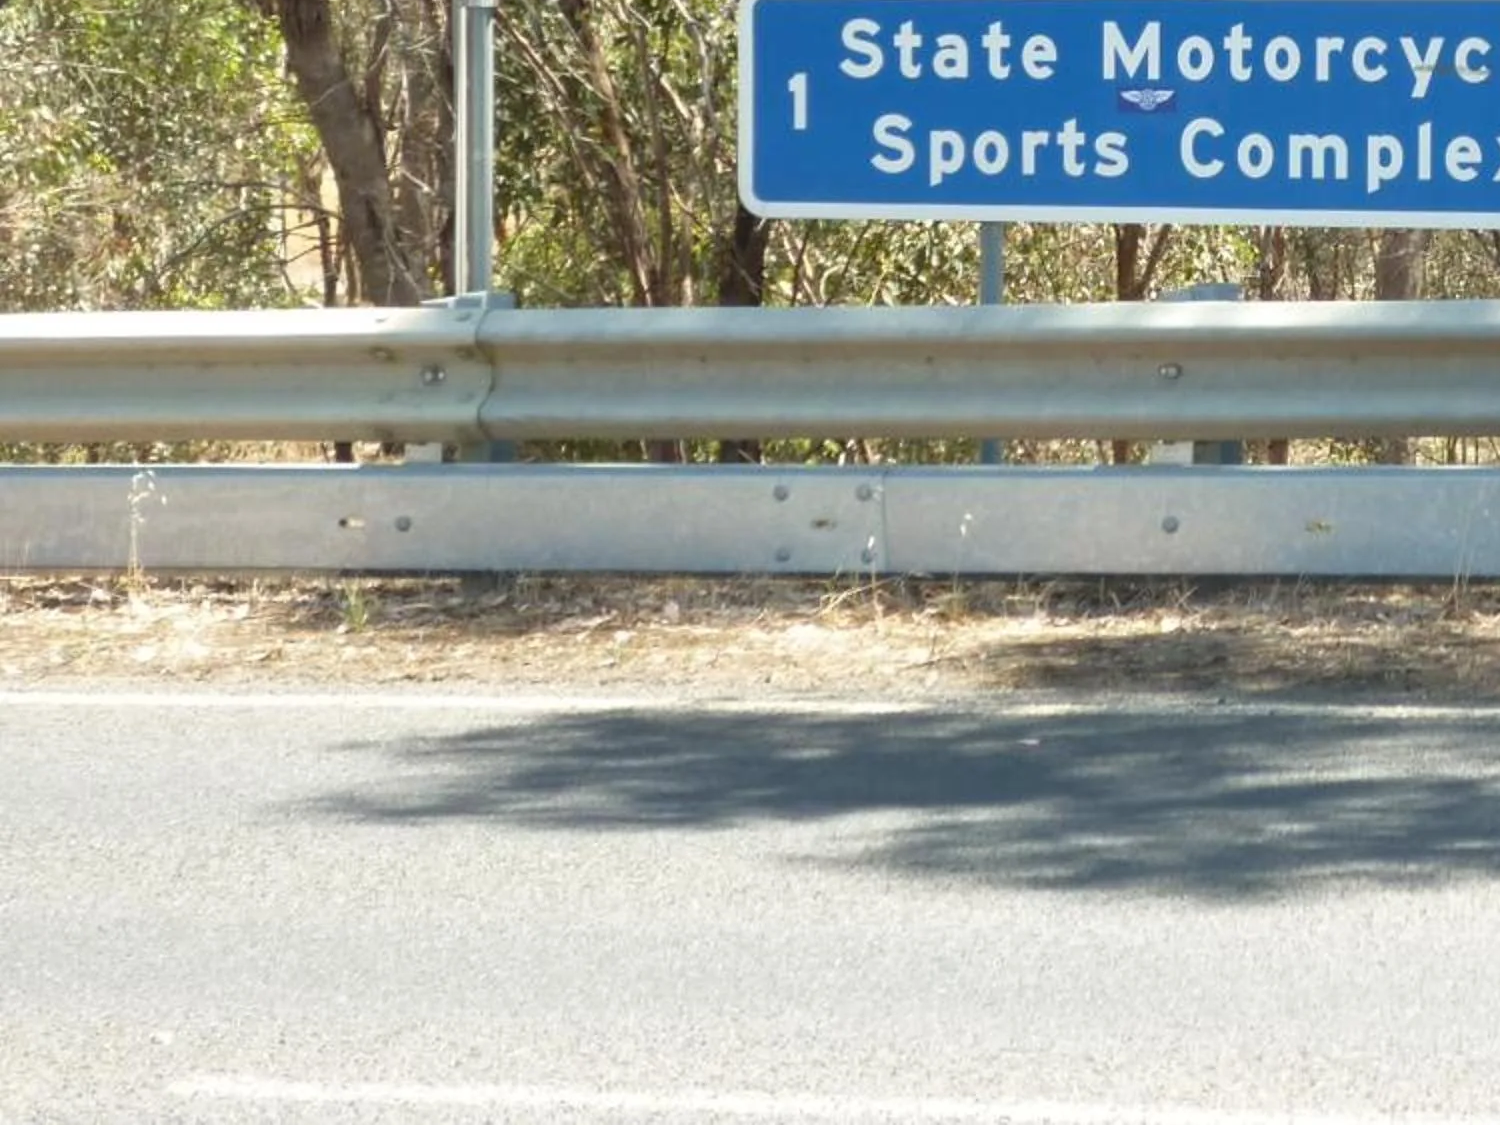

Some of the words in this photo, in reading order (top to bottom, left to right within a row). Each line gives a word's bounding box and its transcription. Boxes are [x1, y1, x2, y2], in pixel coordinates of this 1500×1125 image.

[841, 19, 1056, 79] State
[789, 74, 806, 129] 1
[872, 114, 1128, 185] Sports
